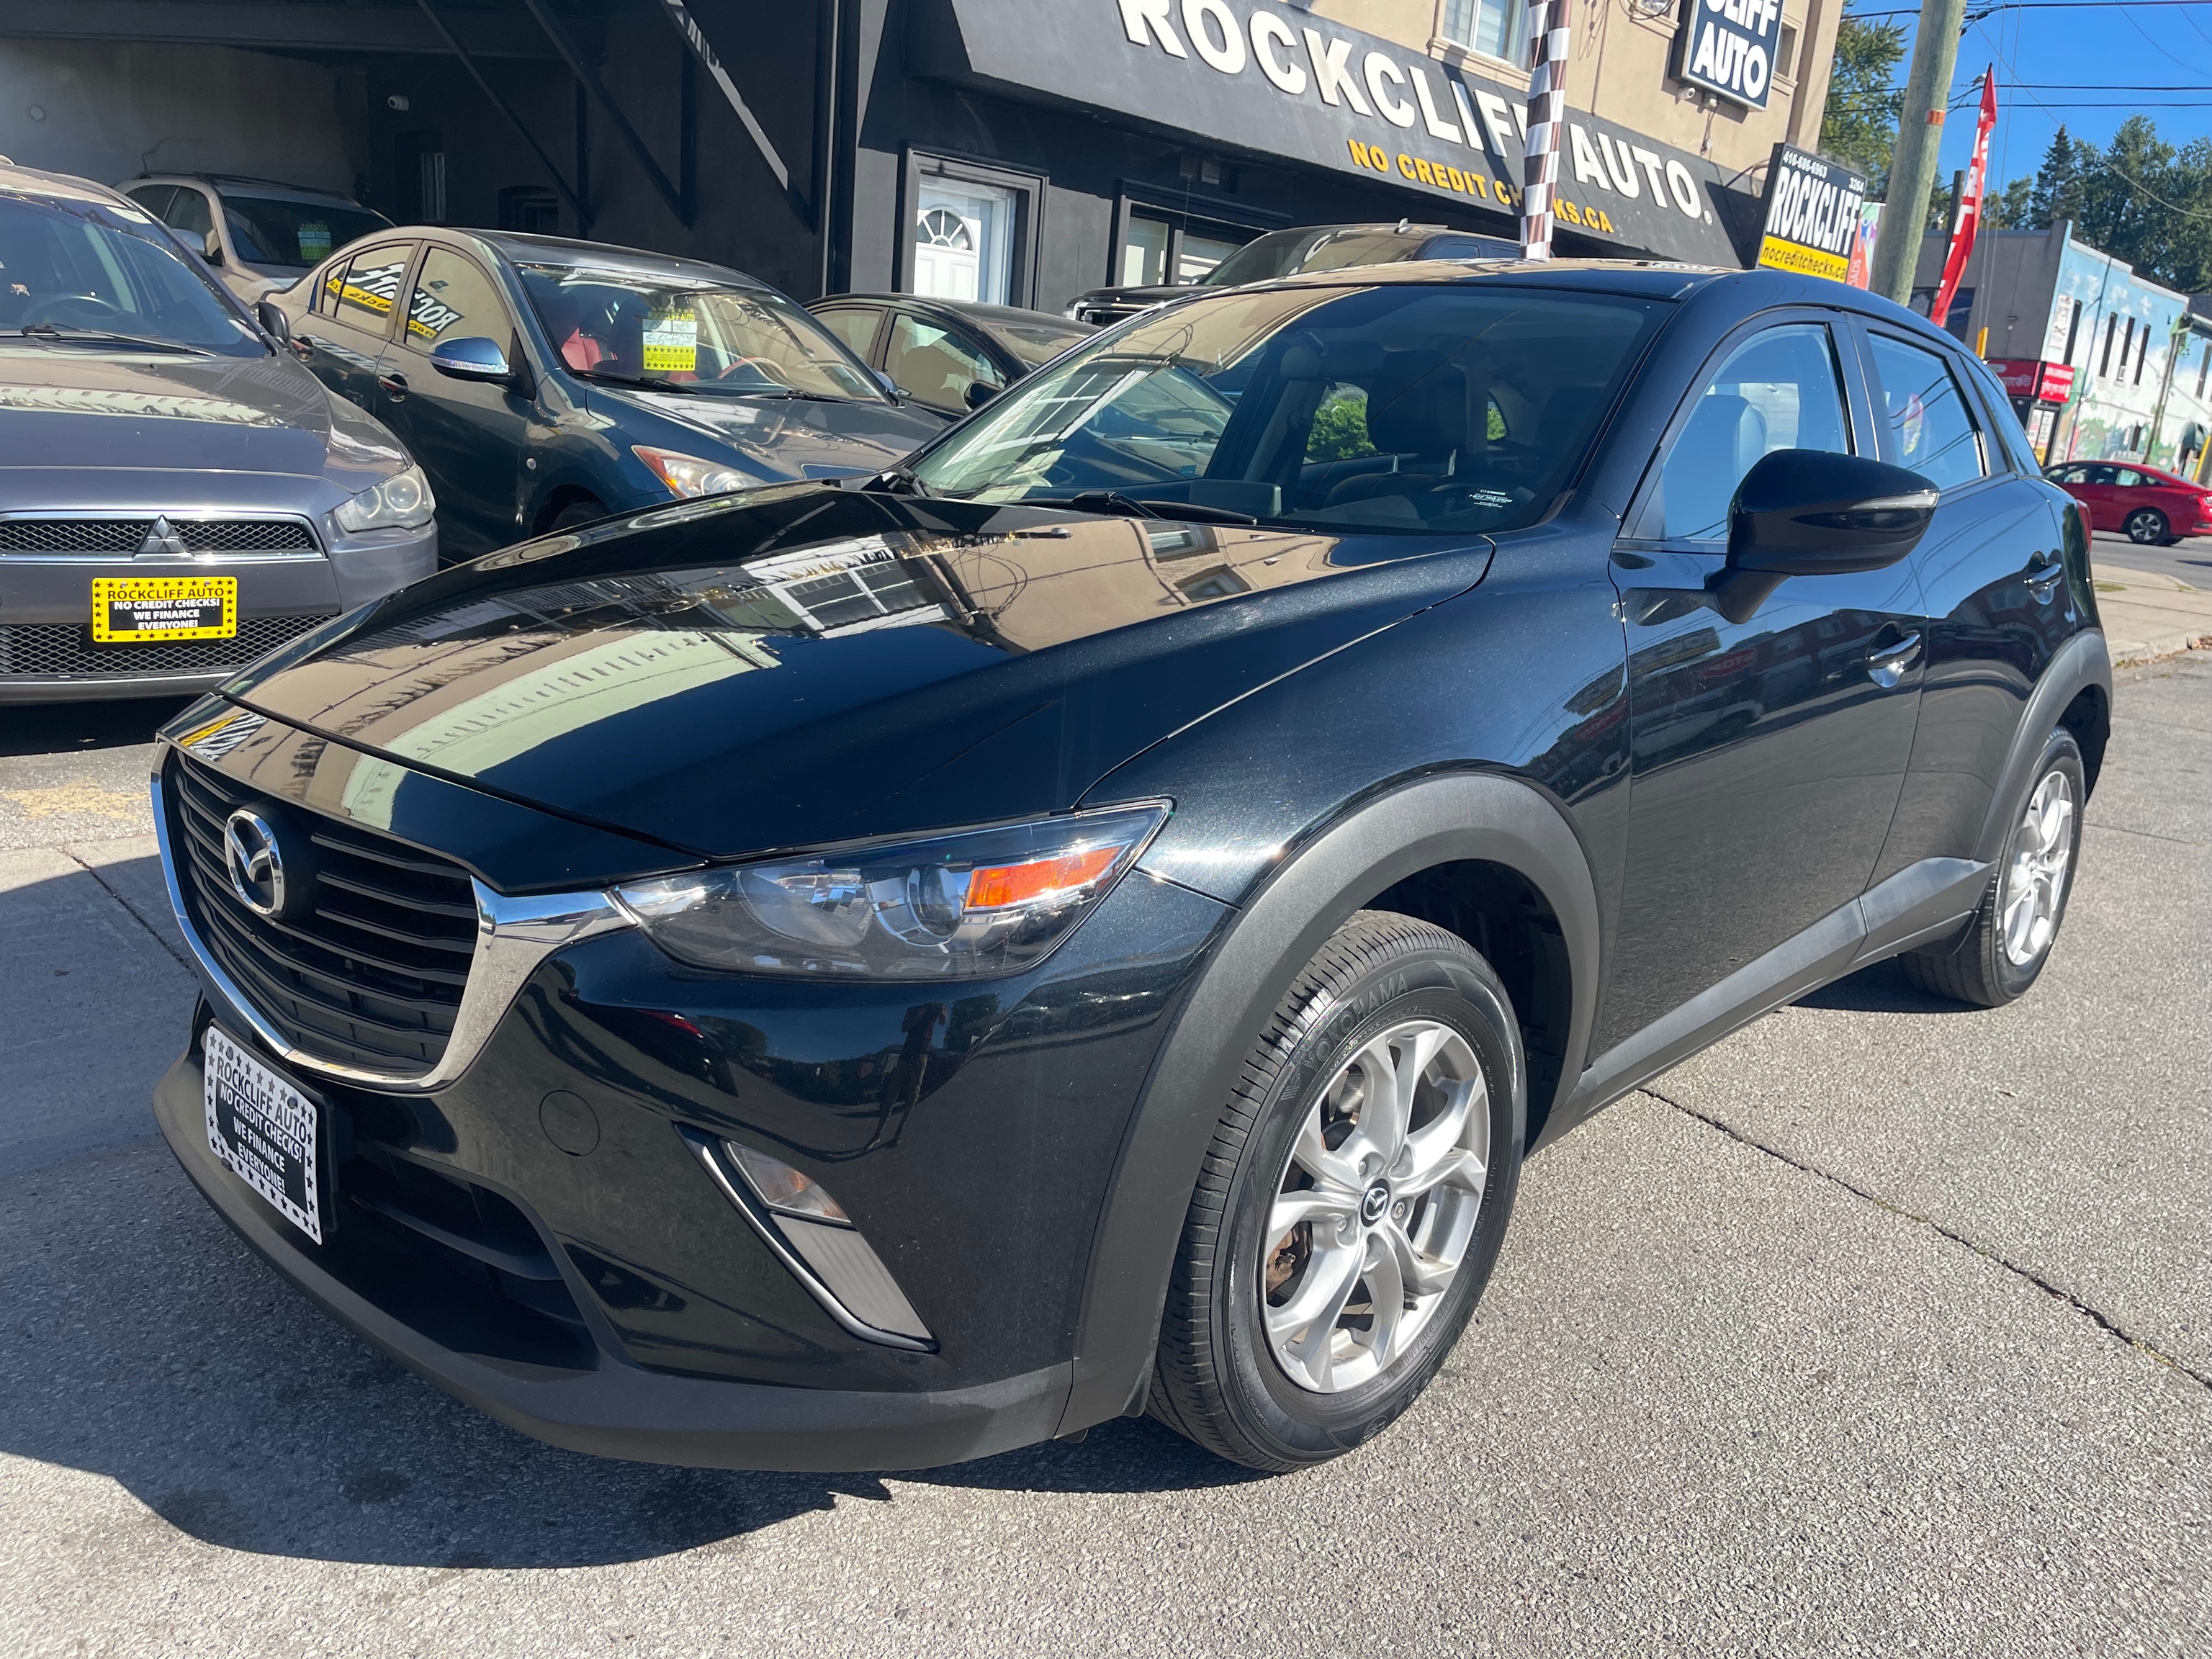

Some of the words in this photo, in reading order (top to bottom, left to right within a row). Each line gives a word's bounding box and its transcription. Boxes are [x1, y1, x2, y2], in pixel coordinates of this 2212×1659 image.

[1118, 0, 1527, 157] ROCKCLIF
[1692, 21, 1768, 99] AUTO
[1348, 139, 1389, 172] NO
[1397, 153, 1488, 198] CREDIT
[1493, 180, 1614, 233] CHKS.CA
[1766, 166, 1862, 255] ROCKCLIFF
[1761, 246, 1847, 279] nocreditchecks.ca
[680, 313, 696, 322] AUTO
[108, 589, 184, 599] ROCKCLIFF
[187, 588, 224, 598] AUTO
[114, 601, 132, 610] NO
[133, 600, 174, 610] CREDIT
[175, 598, 220, 608] CHECKS!
[133, 611, 151, 620] WE
[153, 609, 199, 619] FINANCE
[138, 619, 198, 630] EVERYONE!
[1303, 973, 1408, 1073] YOKOHAMA
[217, 1056, 274, 1116] ROCKCLIFF
[274, 1103, 307, 1143] AUTO
[220, 1083, 233, 1105] NO
[234, 1094, 264, 1130] CREDIT
[264, 1120, 302, 1163] CHECKS!
[233, 1116, 247, 1141] WE
[248, 1128, 286, 1173] FINANCE
[237, 1141, 286, 1195] EVERYONE!
